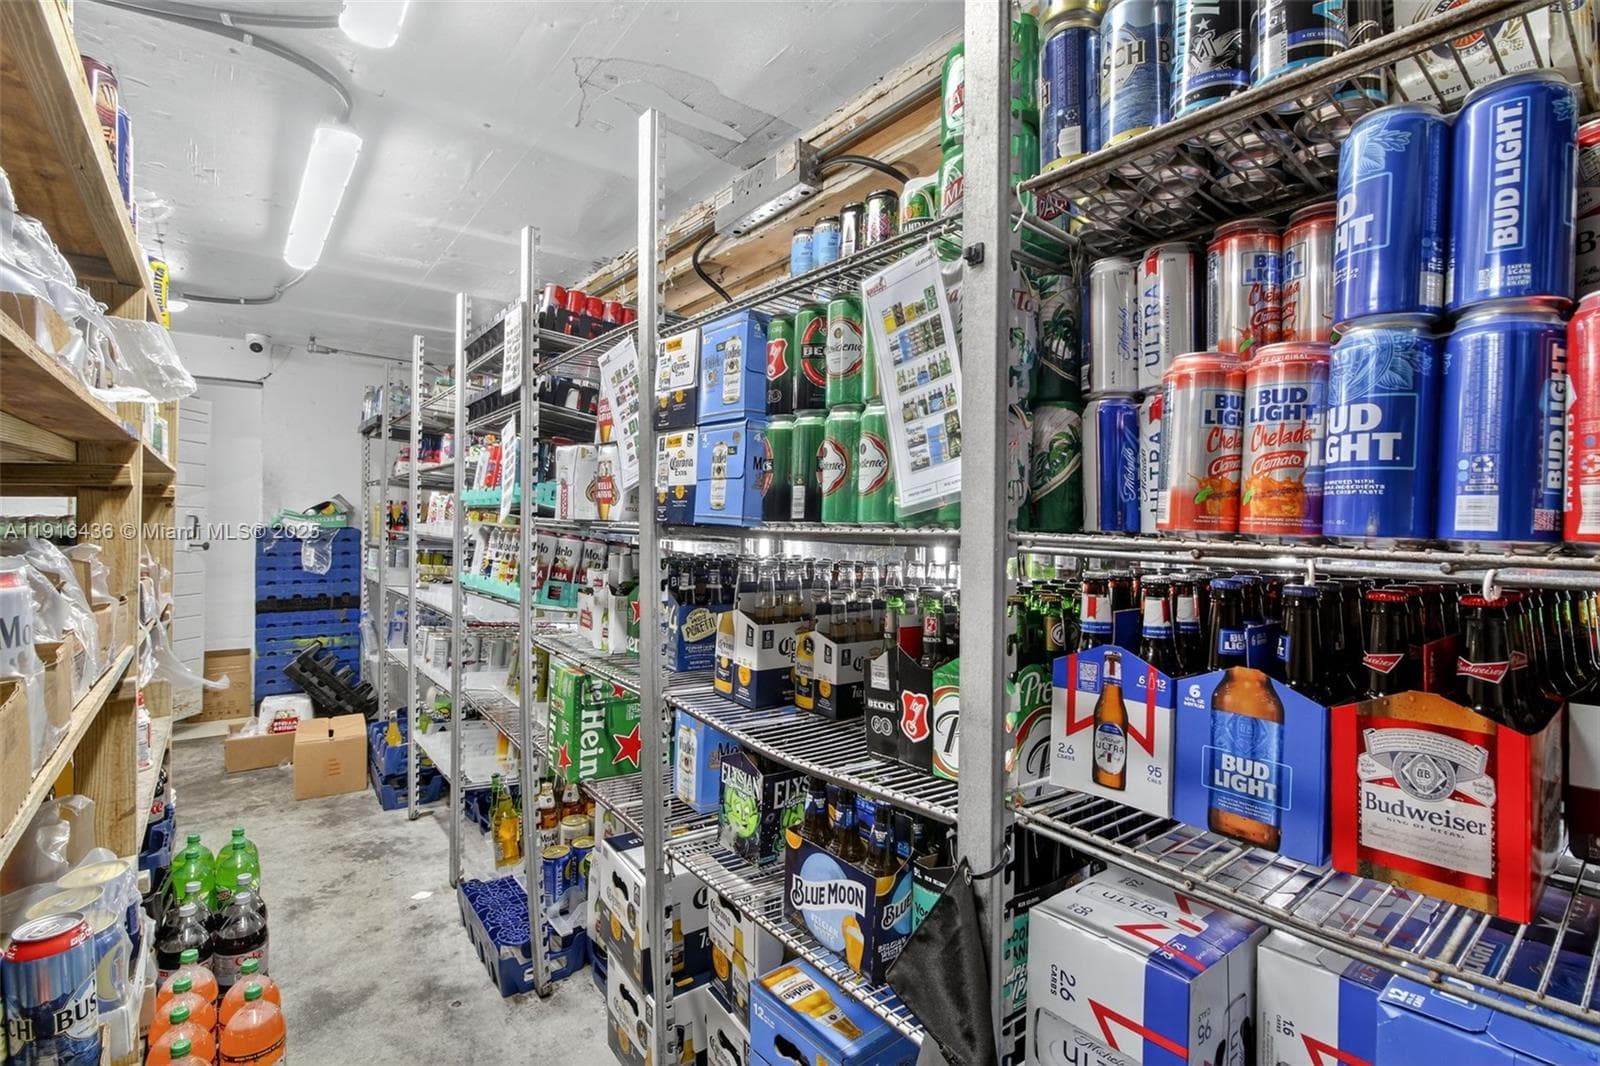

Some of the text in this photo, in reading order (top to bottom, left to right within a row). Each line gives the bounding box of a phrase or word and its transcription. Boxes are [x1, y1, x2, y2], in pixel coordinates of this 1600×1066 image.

[1492, 188, 1521, 248] BUD
[1143, 283, 1161, 368] ULTRA
[1215, 394, 1245, 411] BU
[1259, 387, 1308, 405] BUD
[1249, 404, 1317, 423] LIGHT
[1328, 402, 1382, 434] UD
[1250, 421, 1313, 453] Chelada
[1326, 431, 1402, 464] GHT.
[1254, 454, 1302, 476] Clamato
[1547, 430, 1564, 489] BUD
[1188, 684, 1201, 698] 6
[578, 709, 606, 780] Hein
[1056, 742, 1075, 755] 2.6
[1147, 765, 1162, 779] 95
[1221, 753, 1271, 781] BUD
[721, 762, 764, 806] ELYSIAN
[773, 775, 812, 810] ELYS
[1213, 768, 1277, 801] LIGHT
[1365, 791, 1488, 836] Budweiser
[791, 877, 864, 908] BLUE MOON
[1101, 890, 1170, 919] ULTRA
[1060, 967, 1077, 1003] 2.6
[55, 991, 97, 1033] BUS
[1196, 1021, 1212, 1046] 95
[1282, 1019, 1295, 1038] 1.6
